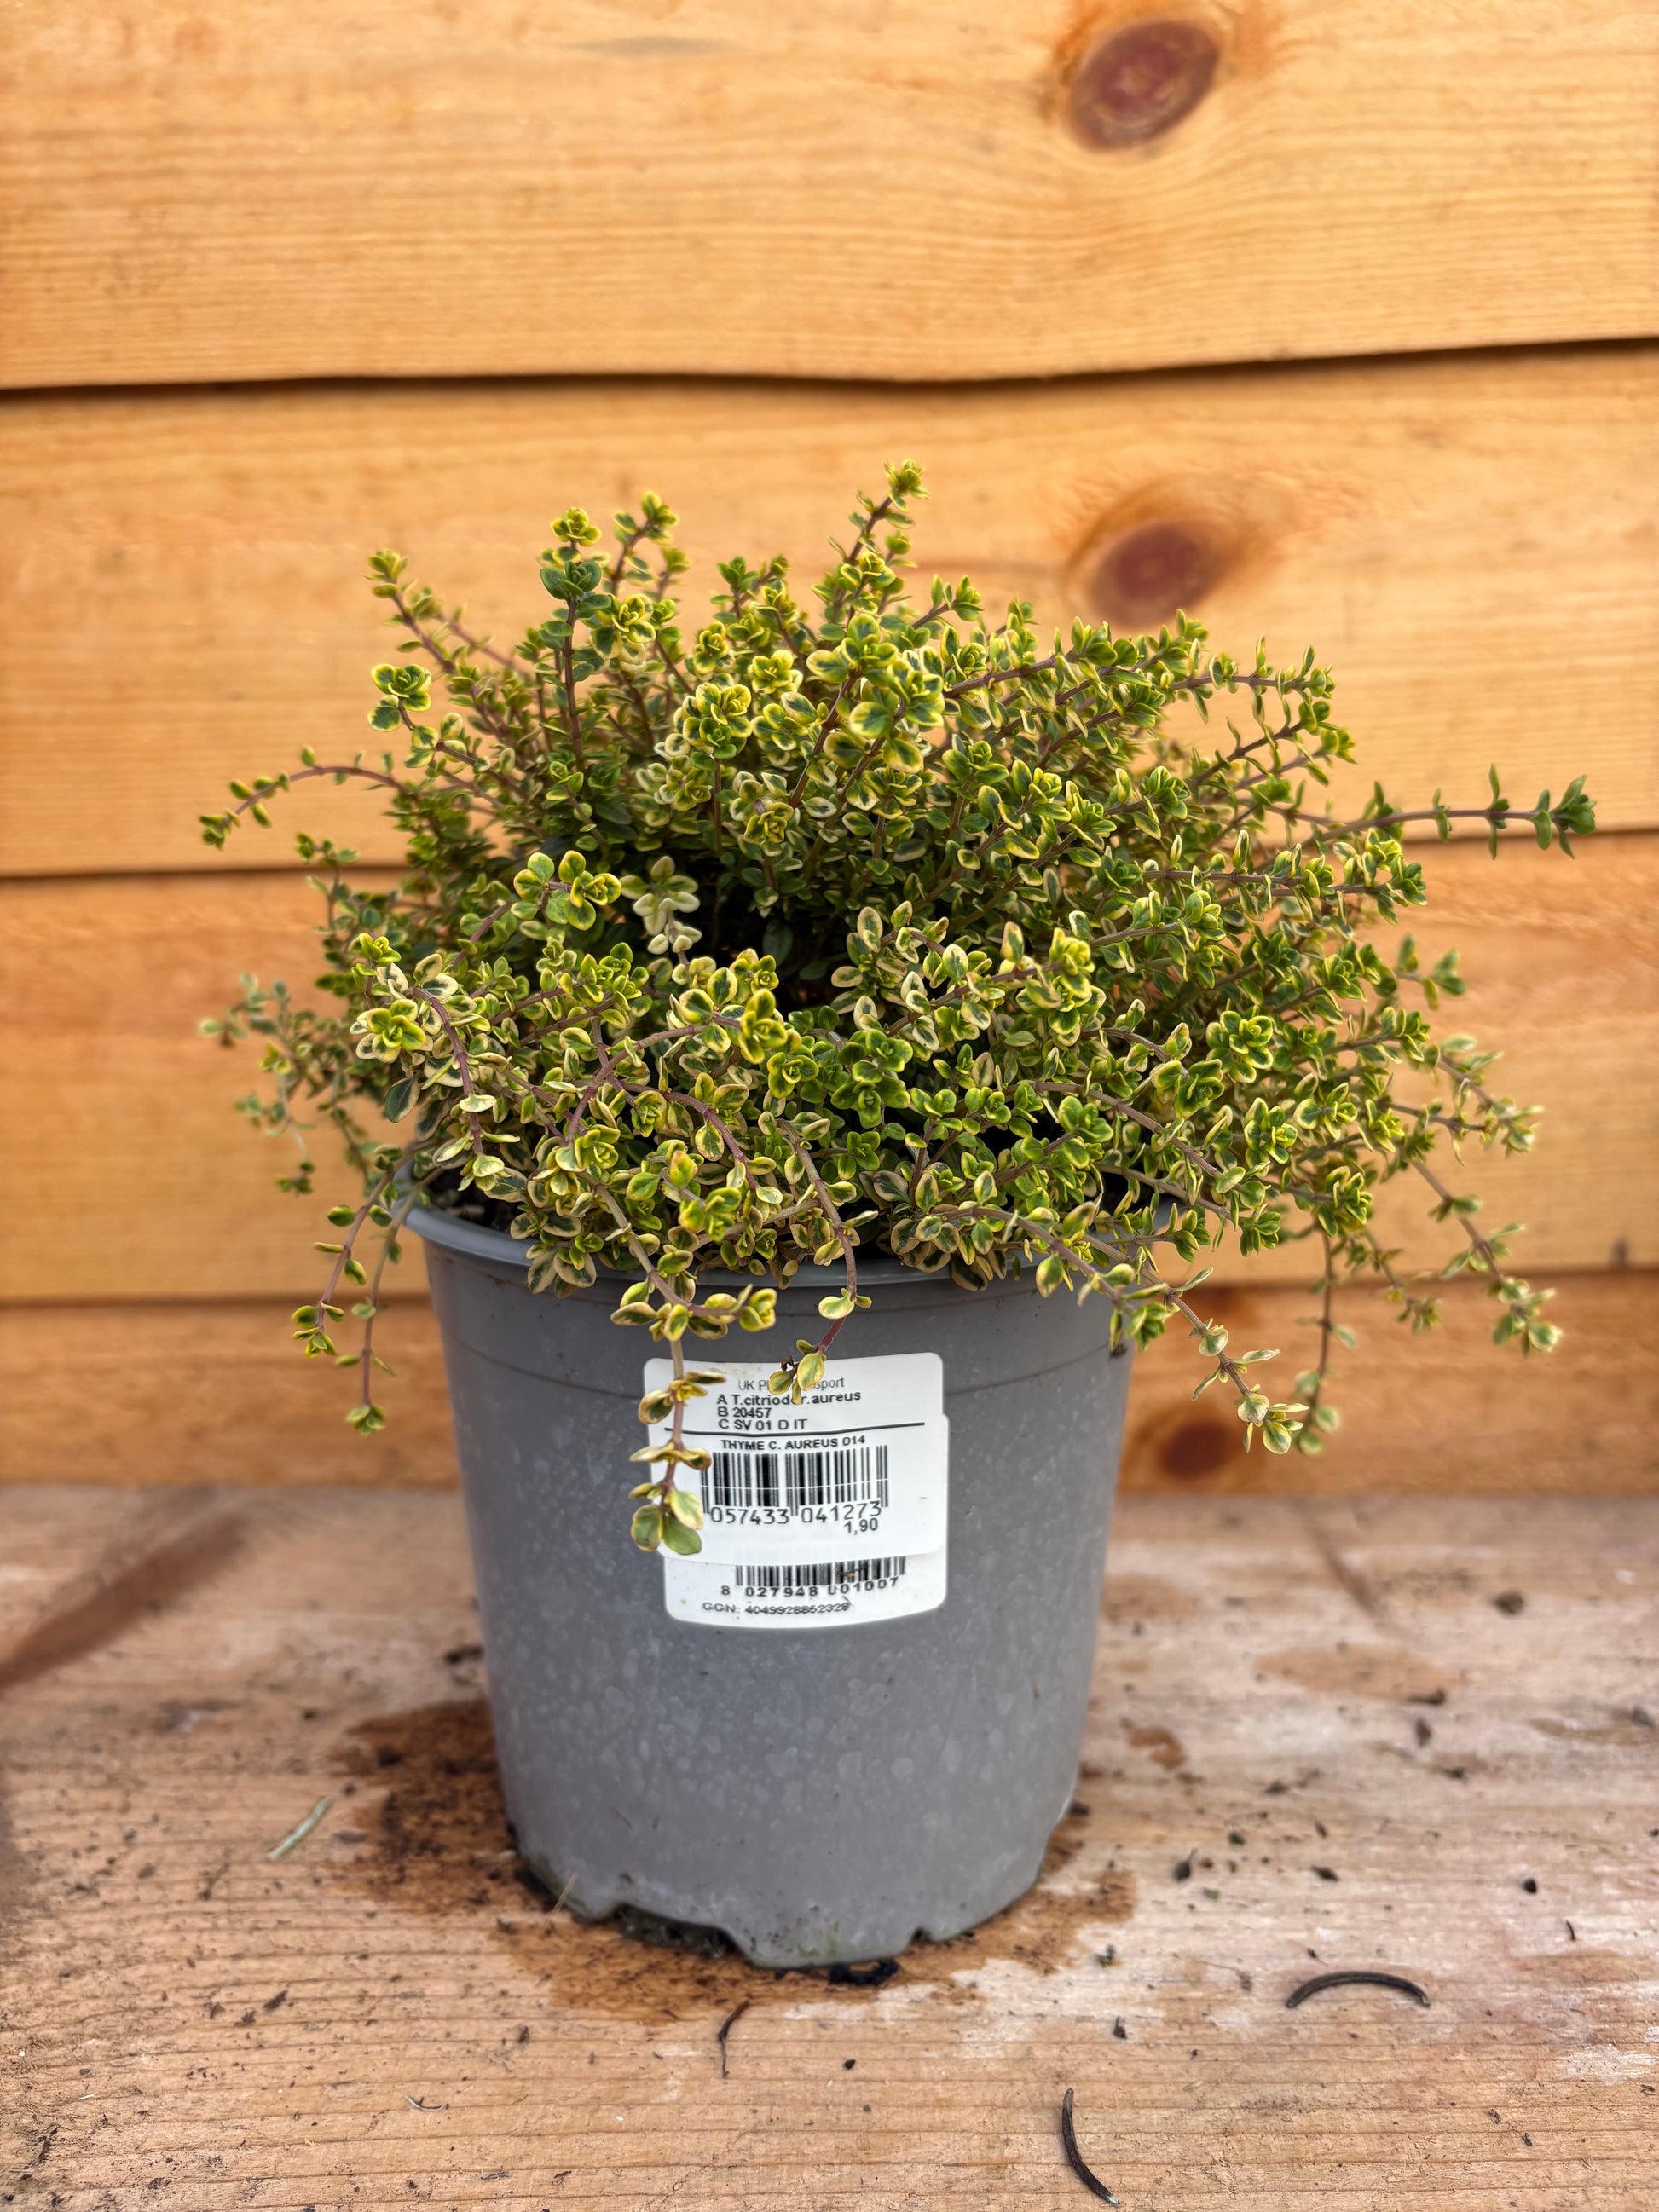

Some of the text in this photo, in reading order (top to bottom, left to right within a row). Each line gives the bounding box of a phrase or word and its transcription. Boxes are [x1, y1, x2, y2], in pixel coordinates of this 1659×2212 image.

[738, 1379, 755, 1391] UK
[717, 1391, 861, 1406] A T.citriodr.aureus
[718, 1407, 772, 1418] B 20457
[719, 1418, 808, 1430] C SV 01 D IT
[721, 1439, 765, 1450] THYME
[768, 1441, 782, 1450] C.
[784, 1438, 838, 1450] AUREUS
[710, 1500, 882, 1525] 057433 041273
[843, 1517, 880, 1535] 1,90
[721, 1585, 731, 1596] 8
[745, 1586, 819, 1597] 027948
